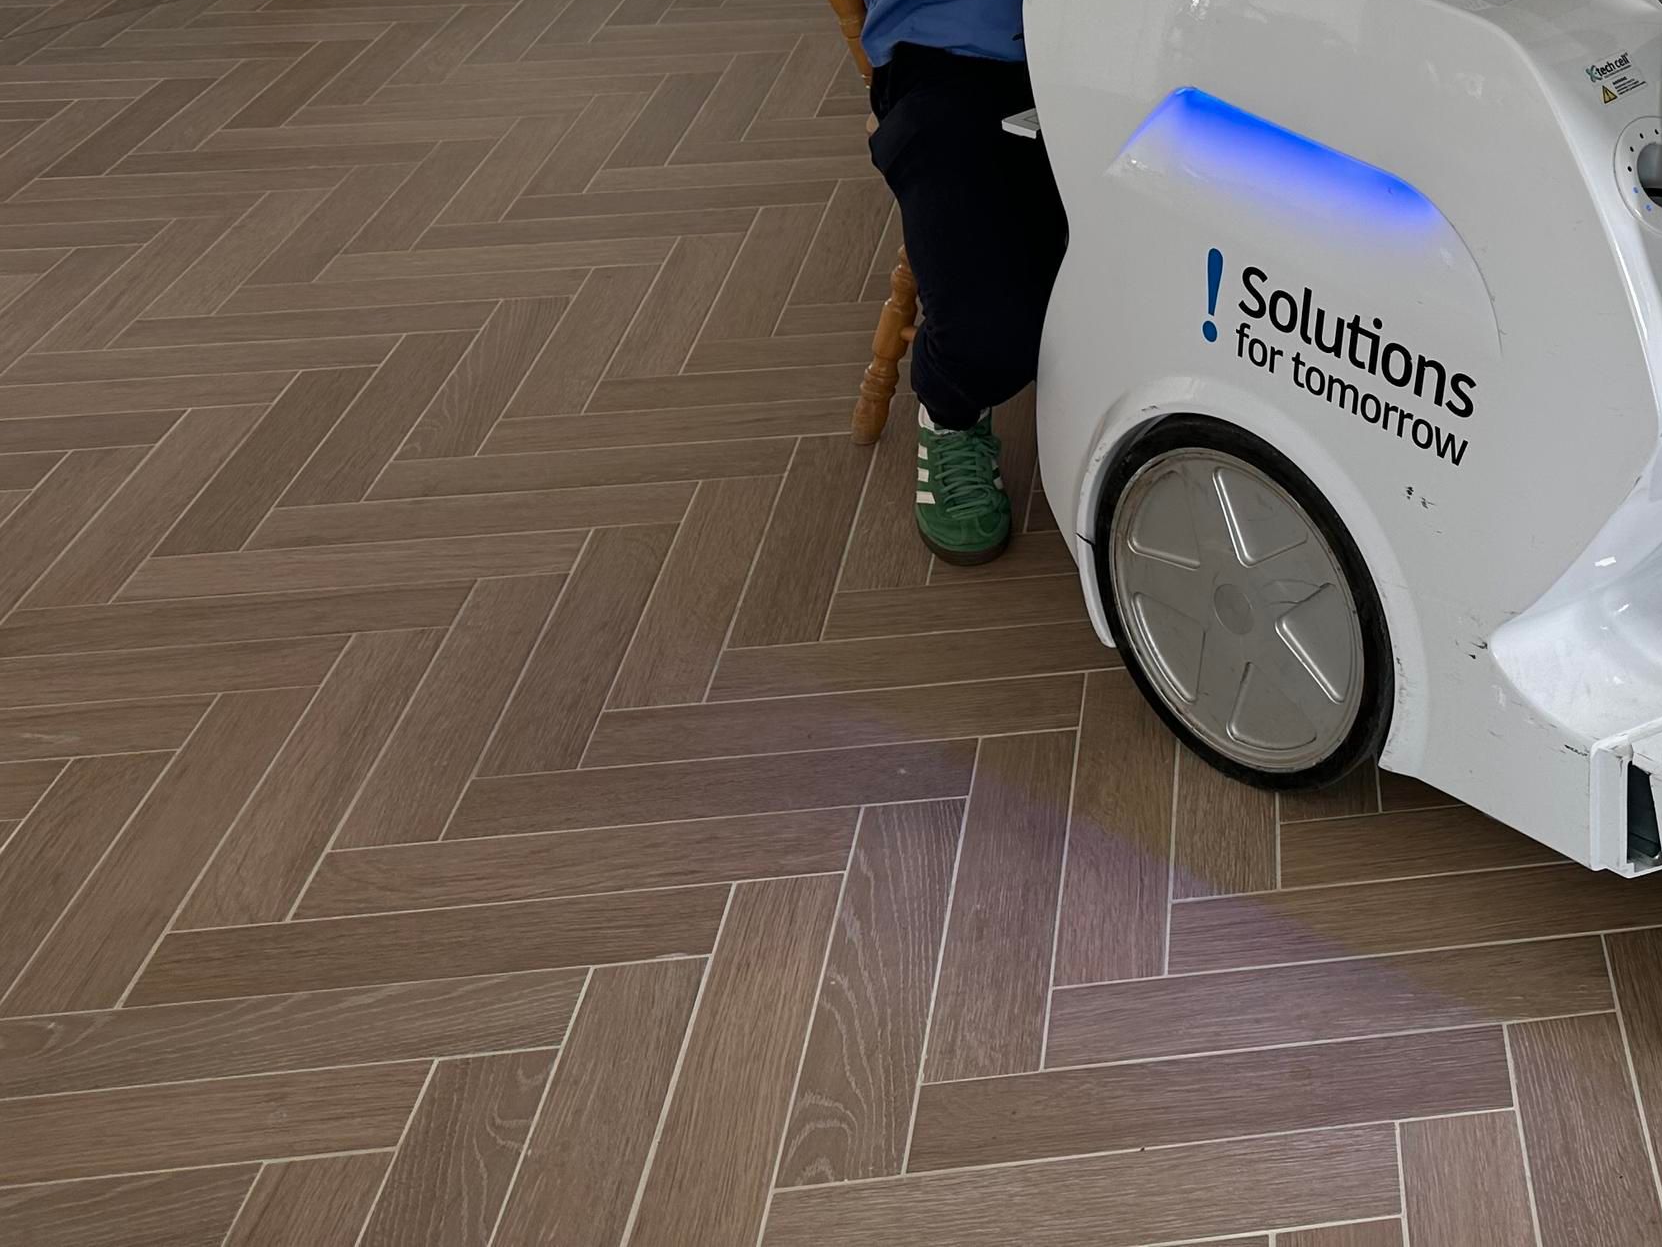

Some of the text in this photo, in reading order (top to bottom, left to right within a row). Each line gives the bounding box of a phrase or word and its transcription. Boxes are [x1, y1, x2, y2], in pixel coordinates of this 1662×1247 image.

[1235, 322, 1469, 467] for tomorrow
[1238, 266, 1477, 419] Solutions
